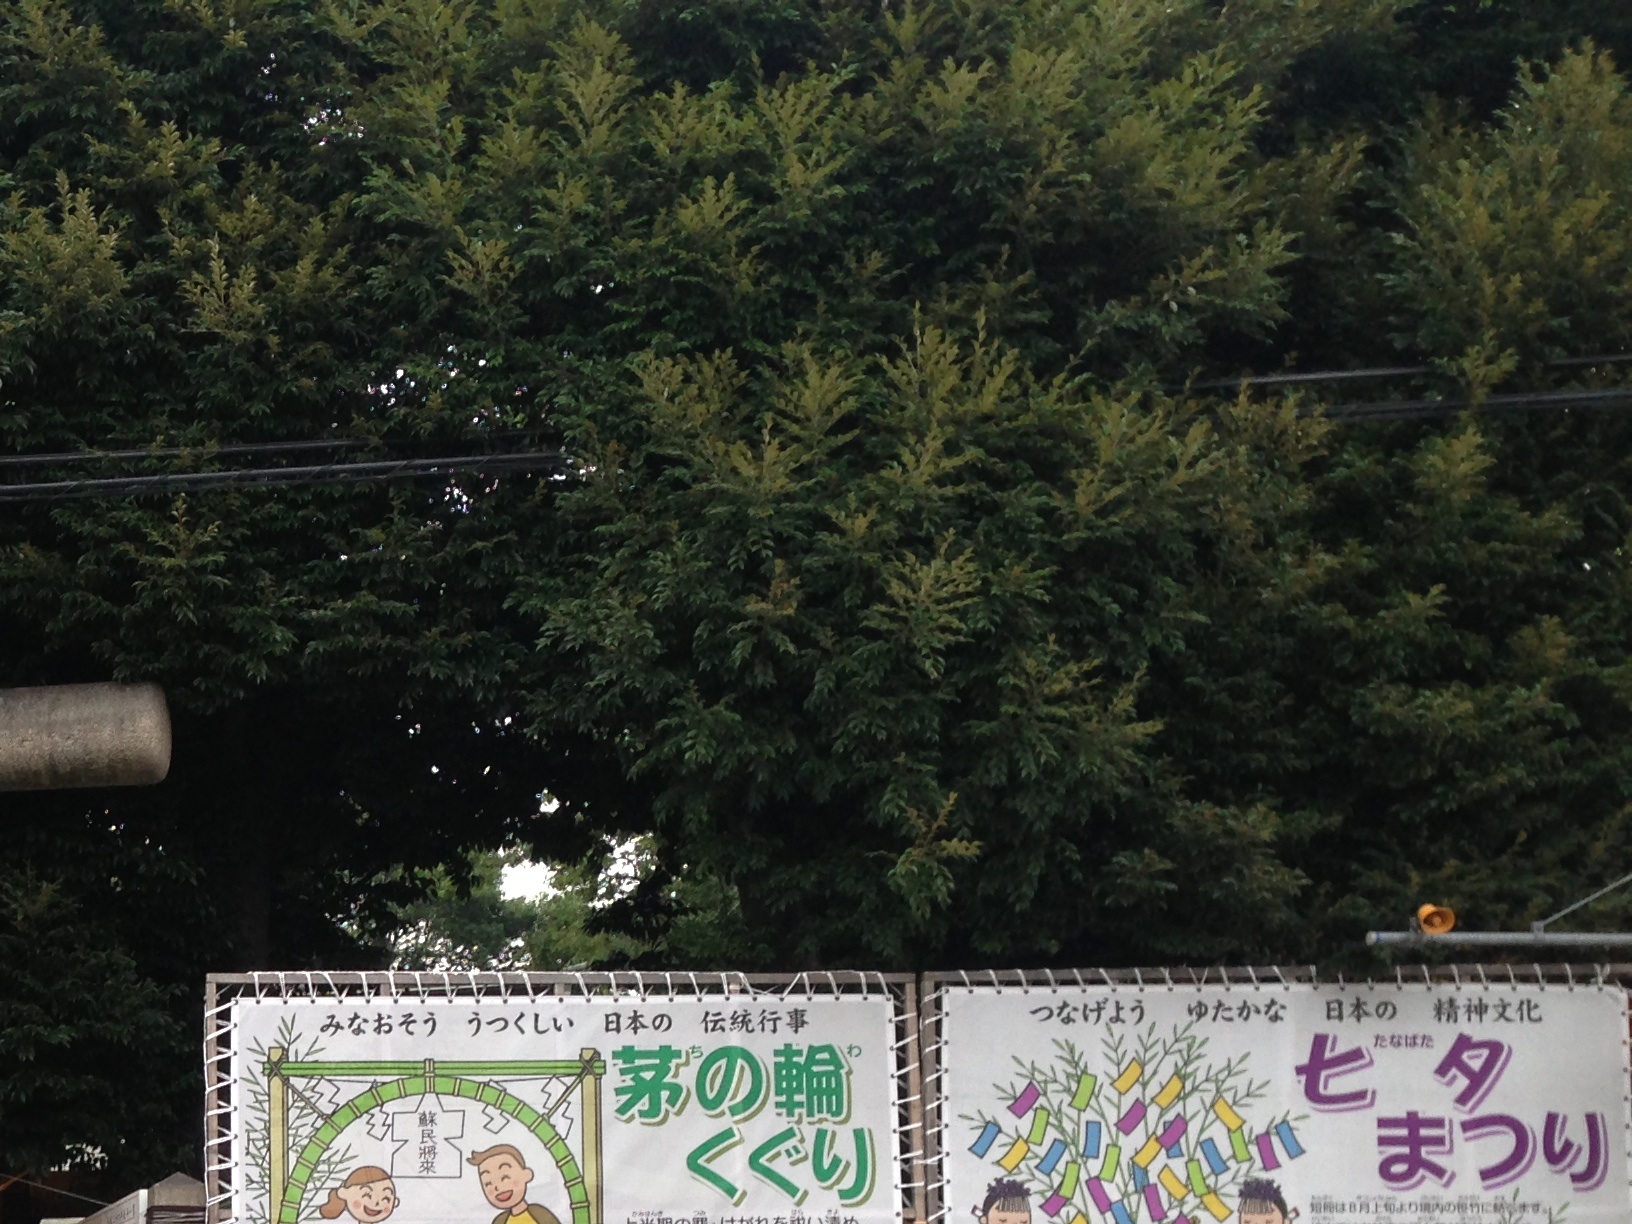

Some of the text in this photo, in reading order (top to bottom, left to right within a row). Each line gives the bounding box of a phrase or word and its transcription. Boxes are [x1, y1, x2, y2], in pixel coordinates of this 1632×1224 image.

[319, 1008, 810, 1035] みなおそう うつくしい 日本の 伝統行事
[1029, 997, 1543, 1025] つなげよう ゆたかな 日本の 精神文化
[1373, 1034, 1434, 1048] たなばた
[611, 1043, 853, 1126] 茅の輪
[686, 1126, 877, 1207] くぐり
[1376, 1110, 1609, 1192] まつり
